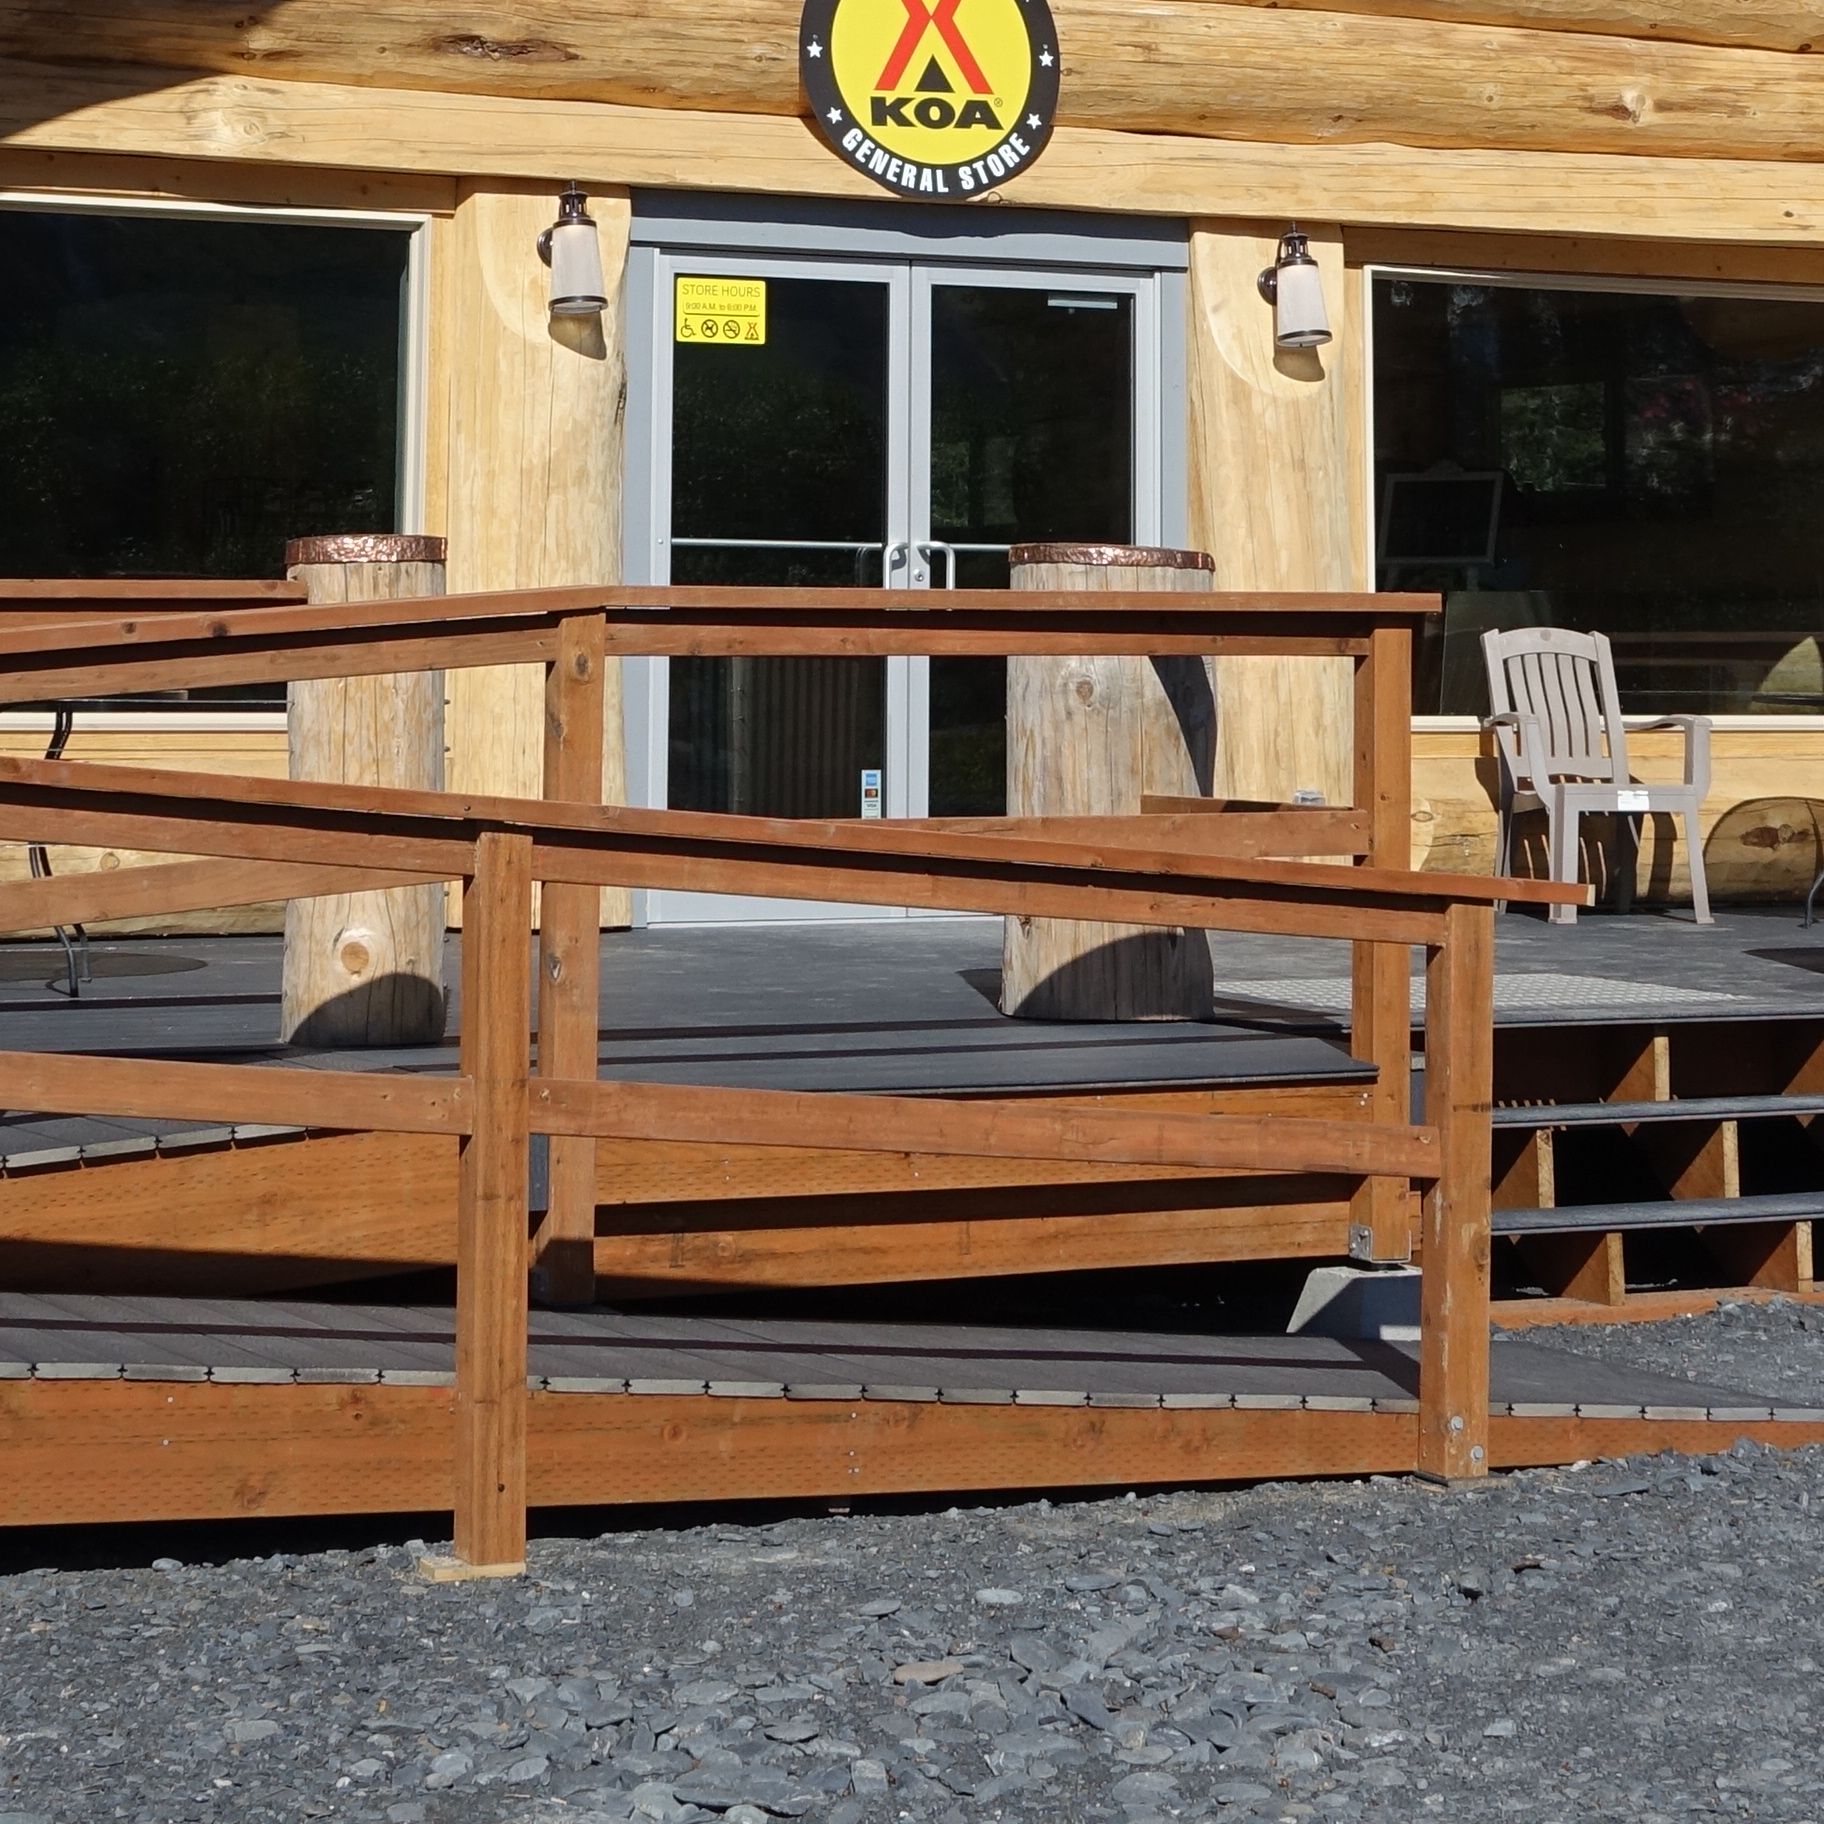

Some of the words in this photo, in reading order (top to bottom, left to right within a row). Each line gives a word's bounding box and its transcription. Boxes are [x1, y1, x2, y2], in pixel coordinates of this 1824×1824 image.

[870, 95, 1005, 131] KOA
[842, 127, 949, 193] GENERAL
[960, 132, 1030, 191] STORE
[682, 283, 718, 296] STORE
[721, 285, 760, 297] HOURS
